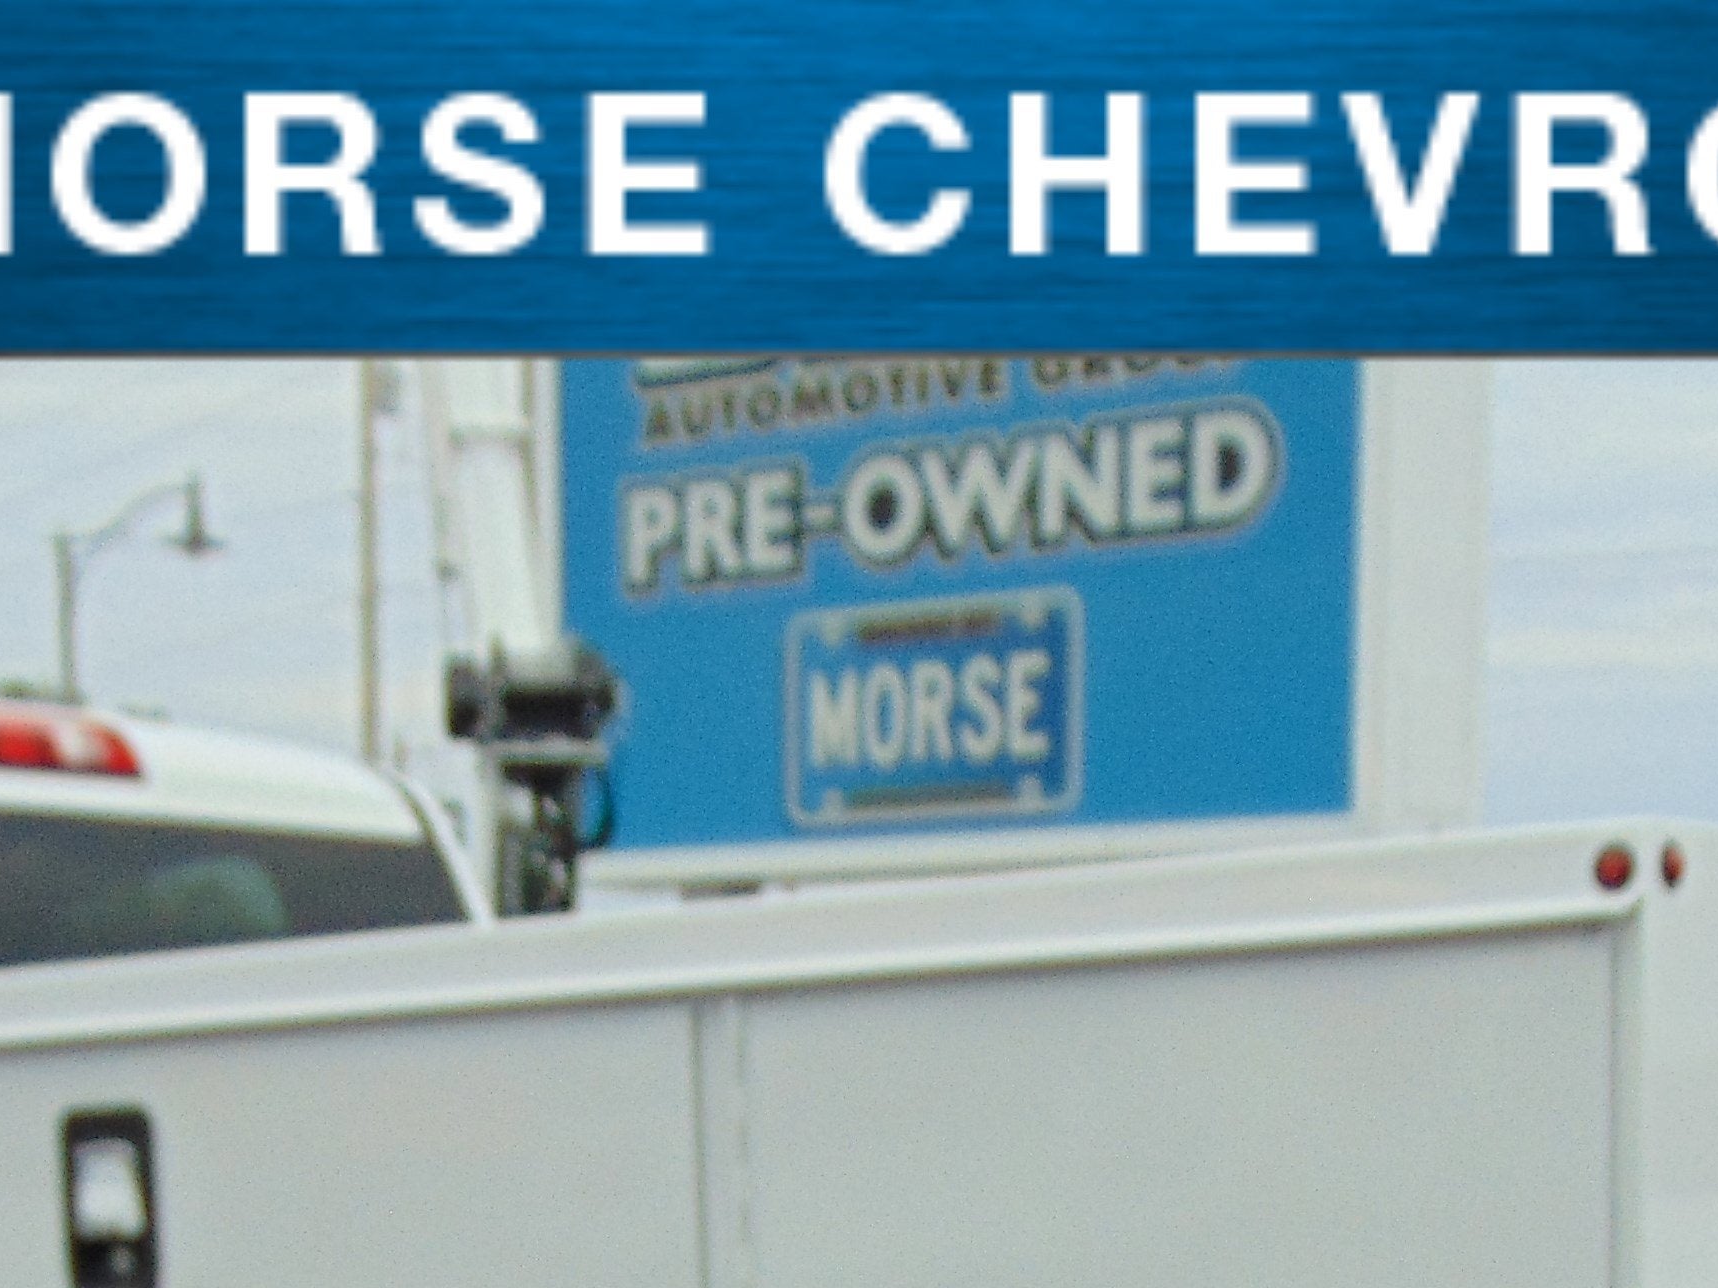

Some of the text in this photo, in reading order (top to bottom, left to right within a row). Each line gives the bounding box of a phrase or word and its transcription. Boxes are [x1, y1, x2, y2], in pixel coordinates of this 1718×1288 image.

[642, 359, 1001, 441] AUTOMOTIVE
[626, 408, 1273, 588] PRE-OWNED
[810, 649, 1051, 768] MORSE
